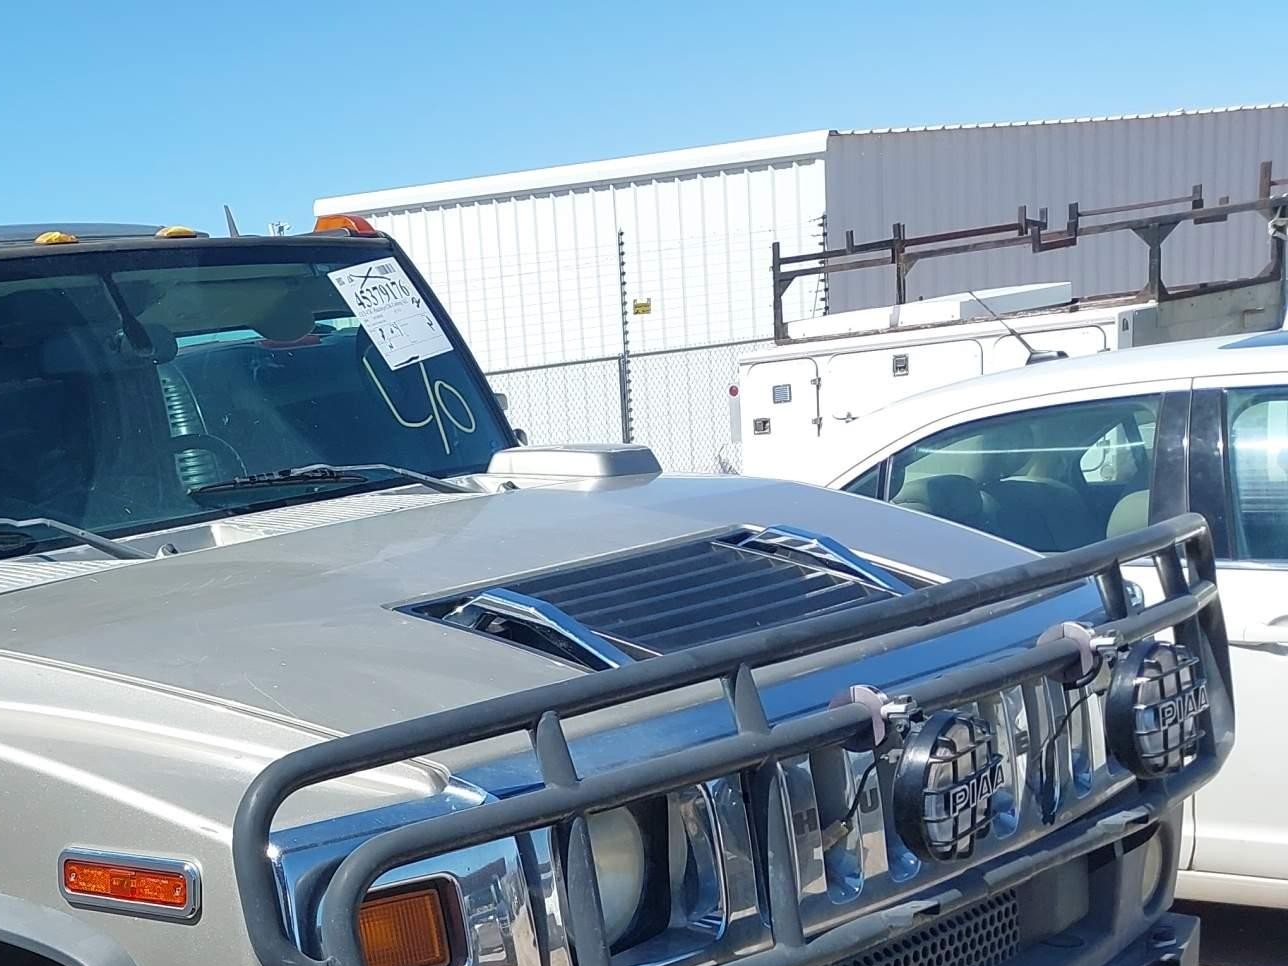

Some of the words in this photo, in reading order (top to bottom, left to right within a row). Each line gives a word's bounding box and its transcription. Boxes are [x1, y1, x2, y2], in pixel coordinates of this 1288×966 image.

[354, 279, 411, 310] 45379176
[1159, 684, 1210, 731] PIAA
[949, 763, 1005, 818] PIAA
